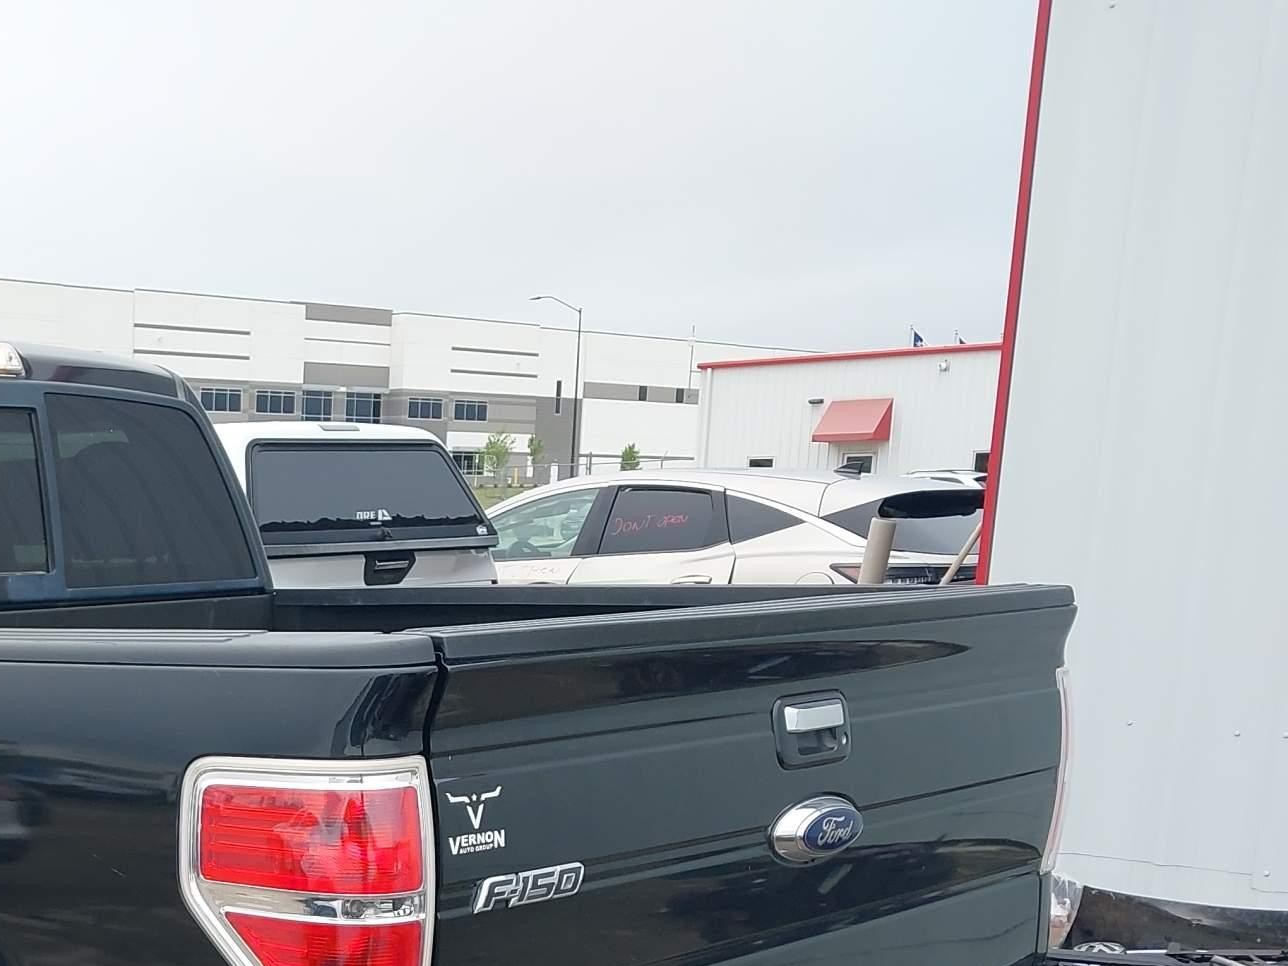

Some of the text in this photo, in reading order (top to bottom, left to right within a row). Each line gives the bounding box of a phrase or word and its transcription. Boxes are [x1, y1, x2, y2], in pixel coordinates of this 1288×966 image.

[448, 829, 505, 855] VERNON
[817, 816, 854, 847] Ford
[459, 843, 494, 855] AUTO GROUP
[473, 862, 585, 914] F-150
